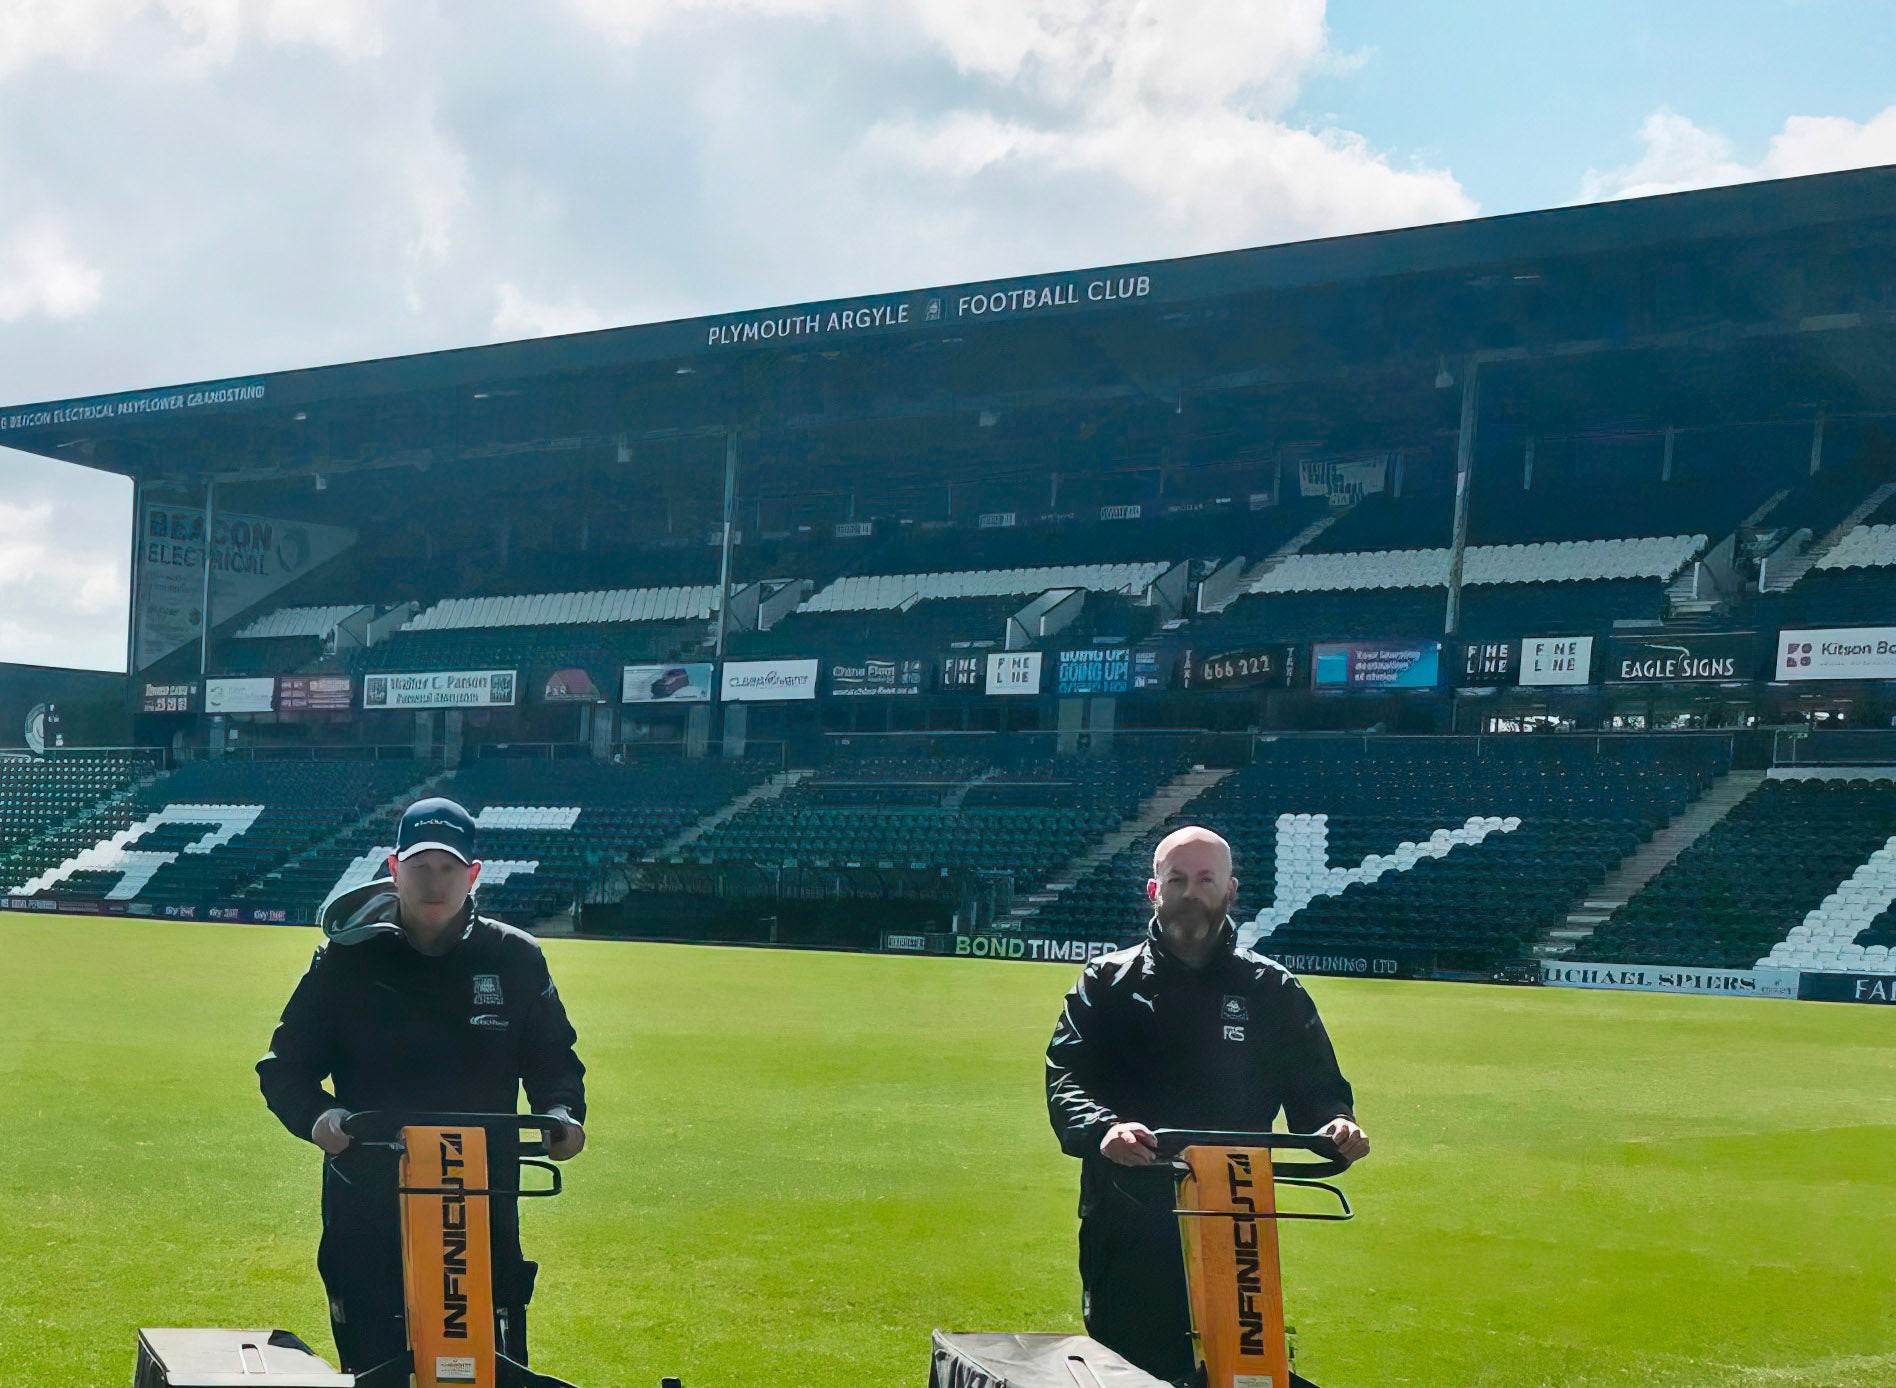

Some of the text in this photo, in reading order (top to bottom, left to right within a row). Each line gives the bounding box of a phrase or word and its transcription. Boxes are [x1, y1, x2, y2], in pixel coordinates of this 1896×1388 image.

[707, 275, 1152, 346] PLYMOUTH ARGYLE FOOTBALL CLUB
[149, 510, 273, 551] BEACON
[1535, 642, 1577, 656] FNE
[1821, 642, 1872, 656] Kitson
[997, 657, 1030, 669] FNE
[1204, 660, 1234, 680] 666
[1534, 657, 1576, 671] LNE
[1620, 658, 1735, 679] EAGLE SIGNS
[996, 671, 1029, 684] LNE
[954, 935, 1025, 959] BOND
[439, 1141, 468, 1339] INFINICUT
[1227, 1161, 1265, 1356] INFINICUT
